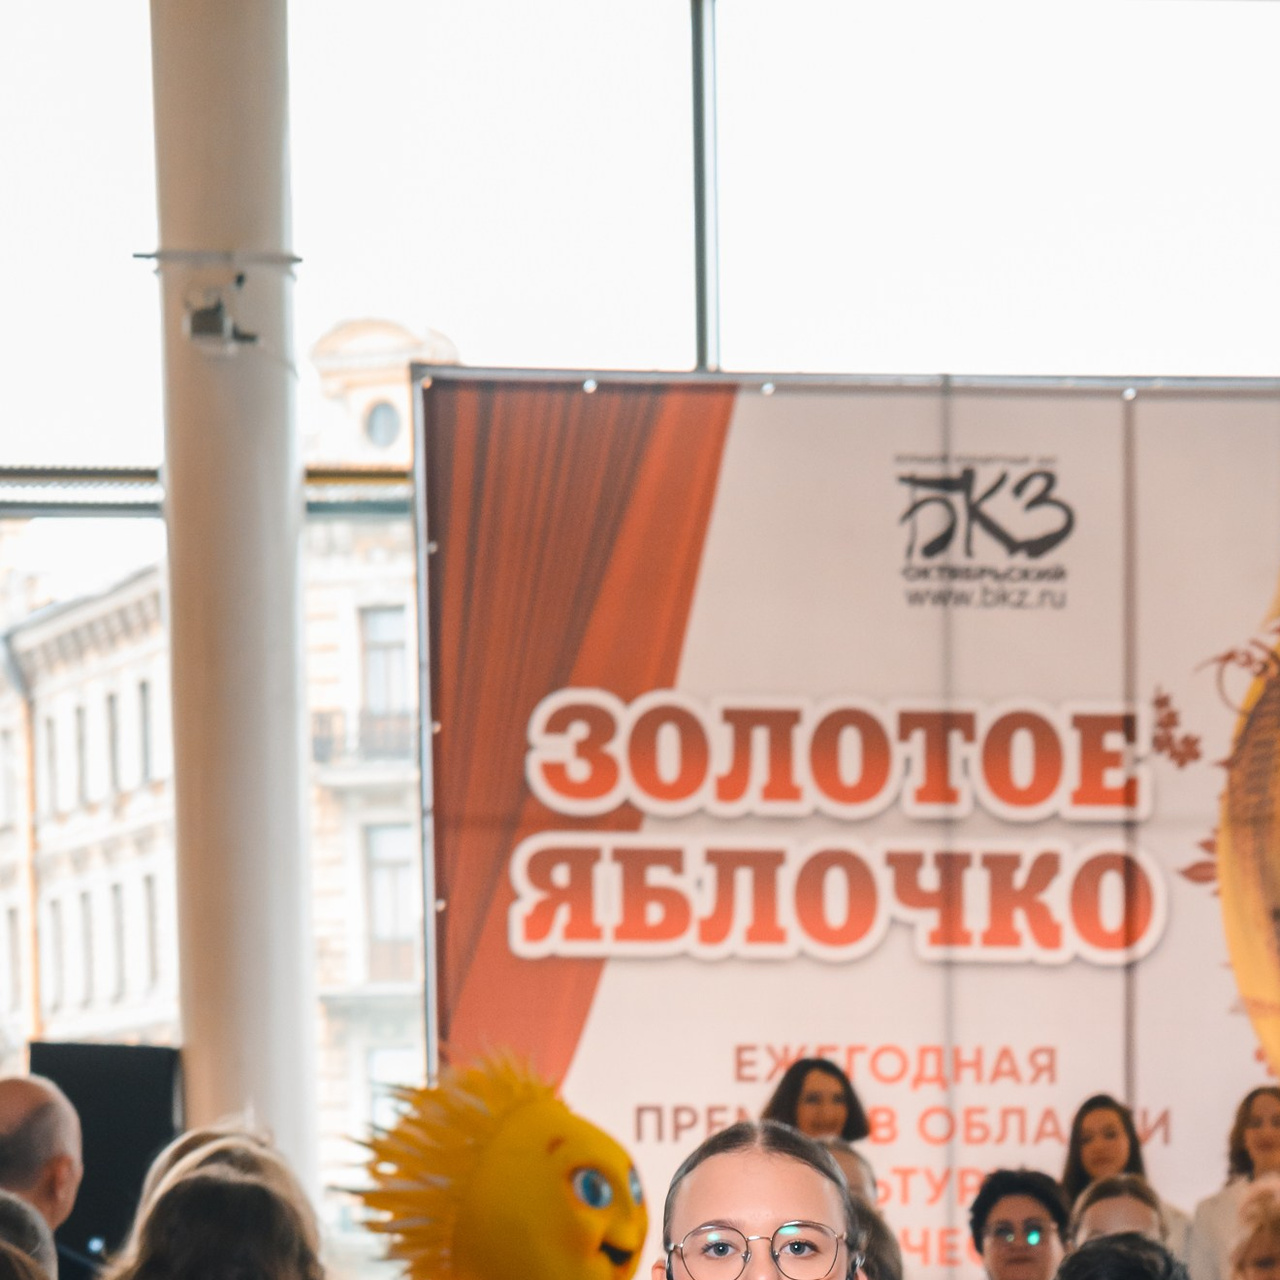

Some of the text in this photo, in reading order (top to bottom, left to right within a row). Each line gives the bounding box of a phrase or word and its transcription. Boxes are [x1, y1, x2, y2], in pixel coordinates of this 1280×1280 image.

[539, 702, 1138, 808] ЗОЛОТОЕ
[522, 847, 1154, 951] ЯБЛОЧКО
[917, 1106, 1171, 1146] ОБЛАИ
